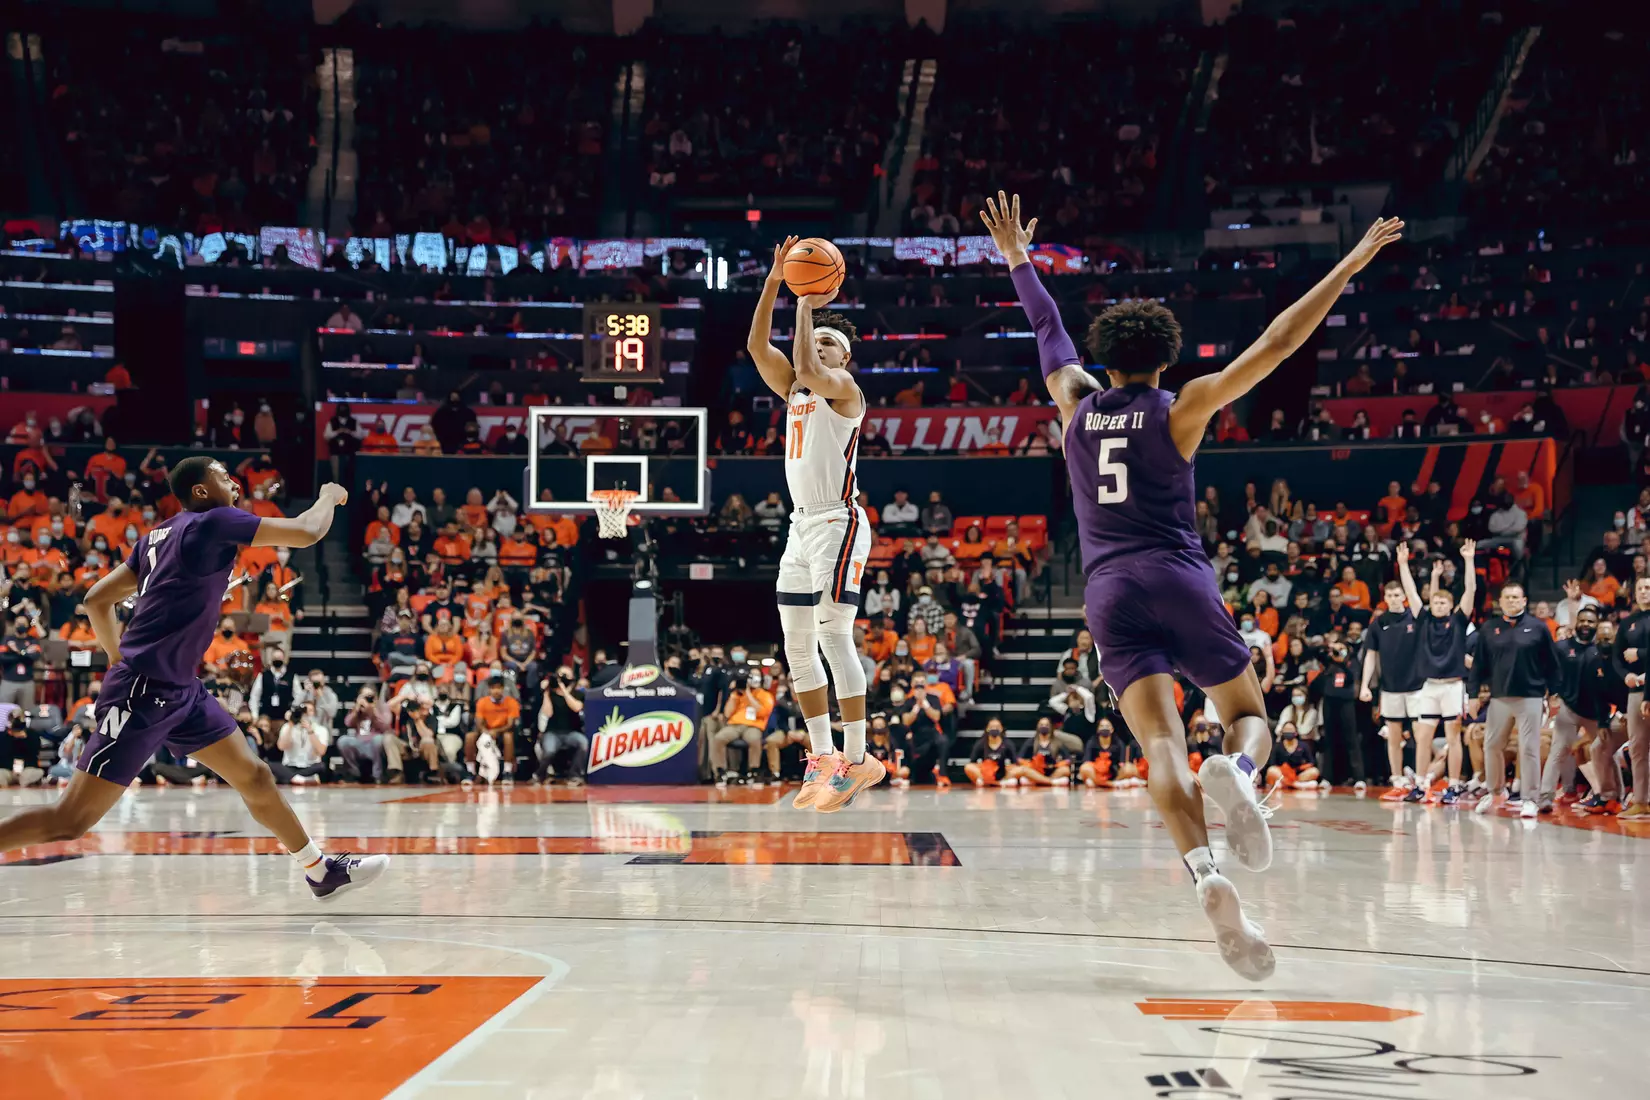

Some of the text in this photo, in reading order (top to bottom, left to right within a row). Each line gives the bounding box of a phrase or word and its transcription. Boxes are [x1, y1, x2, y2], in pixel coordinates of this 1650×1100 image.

[607, 314, 649, 336] 5:38
[615, 337, 643, 371] 19
[1085, 411, 1144, 431] ROPER II
[789, 420, 803, 460] 11
[1098, 437, 1128, 504] 5
[99, 705, 132, 740] N
[591, 720, 683, 767] LIBMAN
